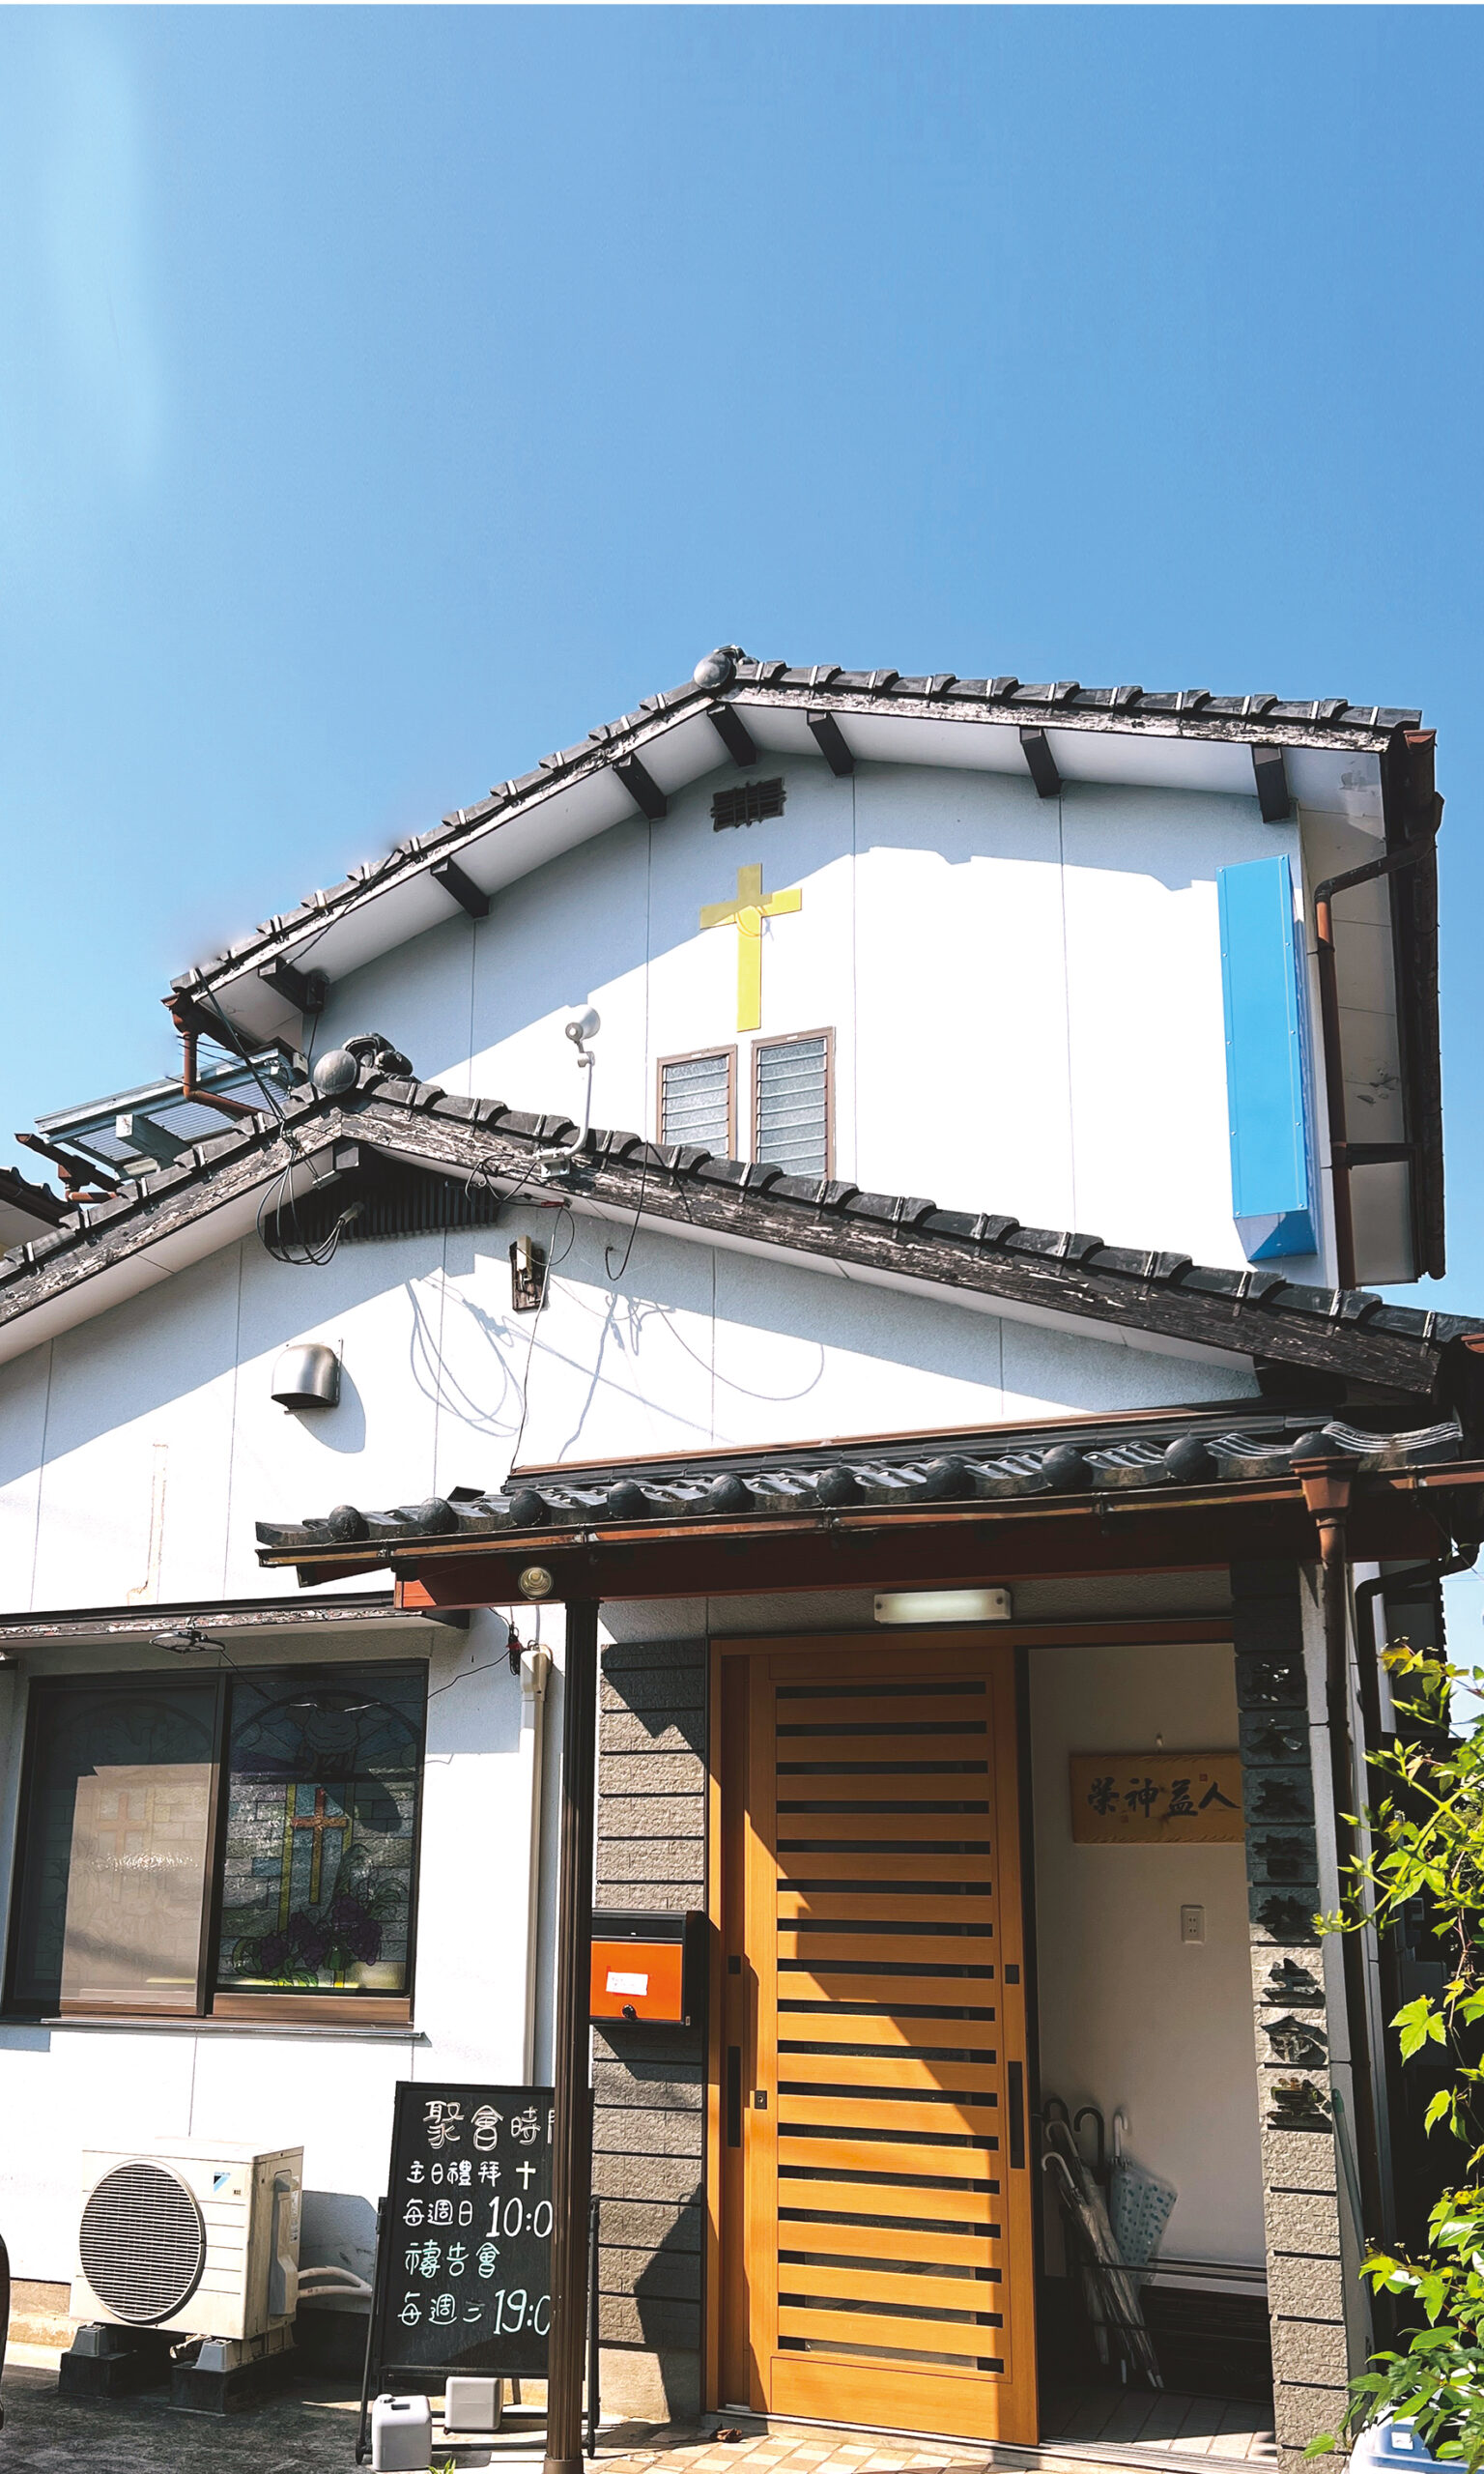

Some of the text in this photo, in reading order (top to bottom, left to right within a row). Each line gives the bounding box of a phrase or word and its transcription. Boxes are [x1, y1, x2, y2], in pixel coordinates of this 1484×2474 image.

[407, 2159, 501, 2187] 主日禮拜
[403, 2195, 554, 2238] 每週日 10:0
[405, 2238, 500, 2279] 禱告會
[397, 2288, 552, 2336] 每週二 19:0
